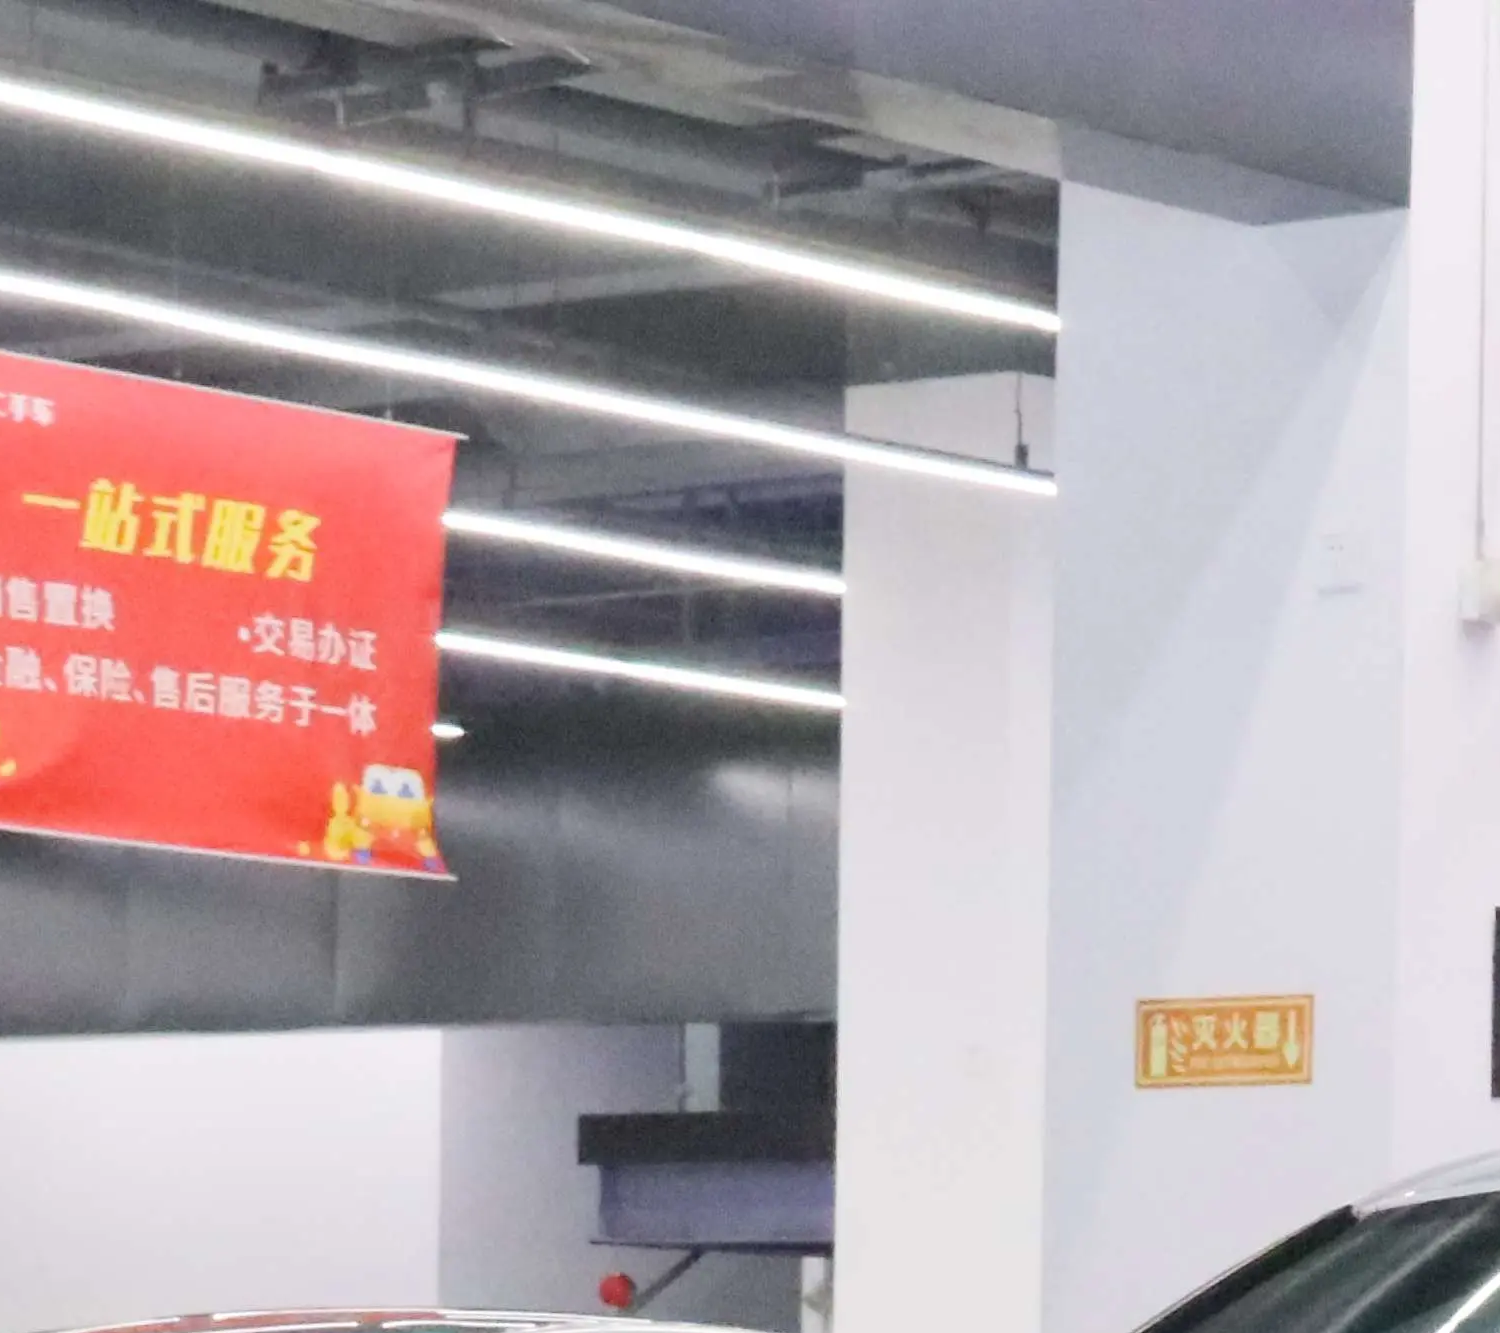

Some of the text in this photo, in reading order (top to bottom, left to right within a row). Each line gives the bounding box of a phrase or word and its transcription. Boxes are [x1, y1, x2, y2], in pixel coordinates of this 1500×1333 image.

[21, 477, 322, 583] 一站式服务
[251, 611, 378, 672] 交易办证
